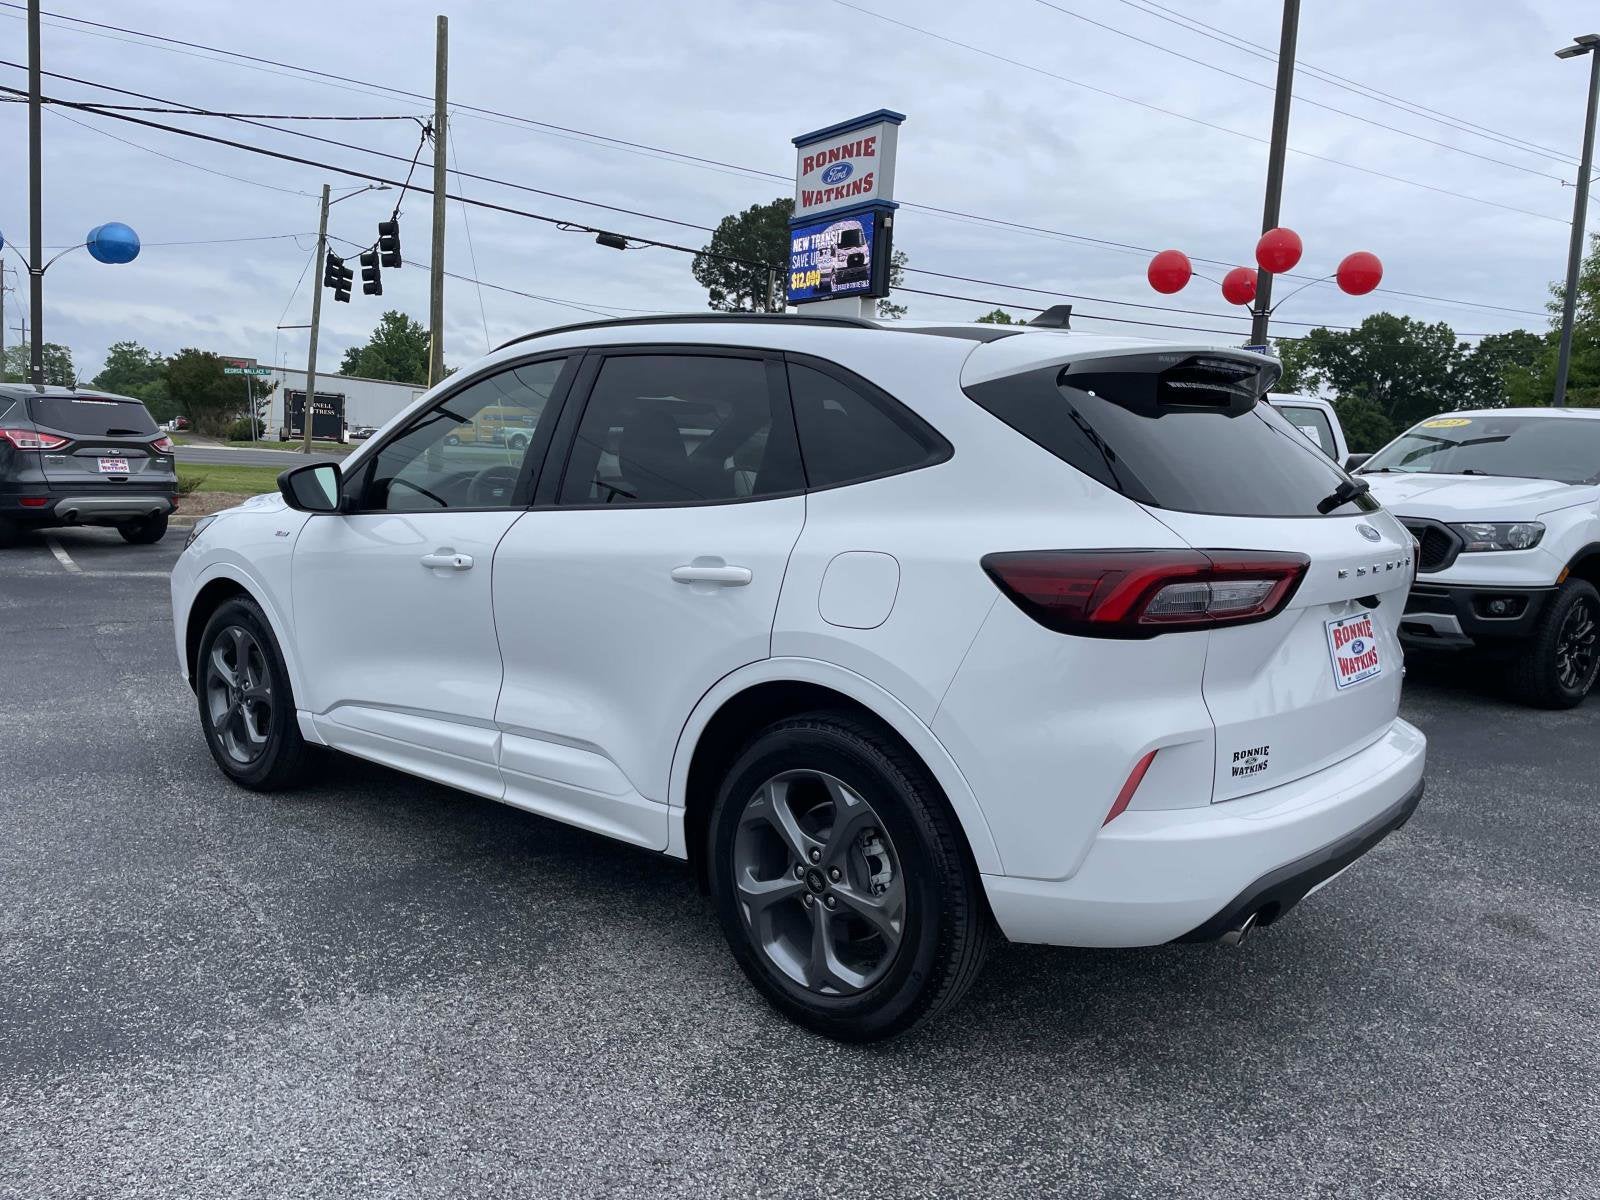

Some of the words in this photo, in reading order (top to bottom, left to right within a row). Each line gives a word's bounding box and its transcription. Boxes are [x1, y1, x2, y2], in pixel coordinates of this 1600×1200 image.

[803, 136, 876, 176] RONNIE
[802, 172, 874, 208] WATKINS
[793, 236, 809, 252] NEW
[811, 229, 842, 250] TRANSIT
[792, 252, 809, 269] SAVE
[302, 407, 335, 415] TRESS
[1338, 557, 1410, 579] ESCAPE
[1333, 620, 1373, 650] RONNIE
[1338, 646, 1378, 676] WATKINS
[1233, 746, 1269, 763] RONNIE
[1232, 760, 1268, 777] WATKINS
